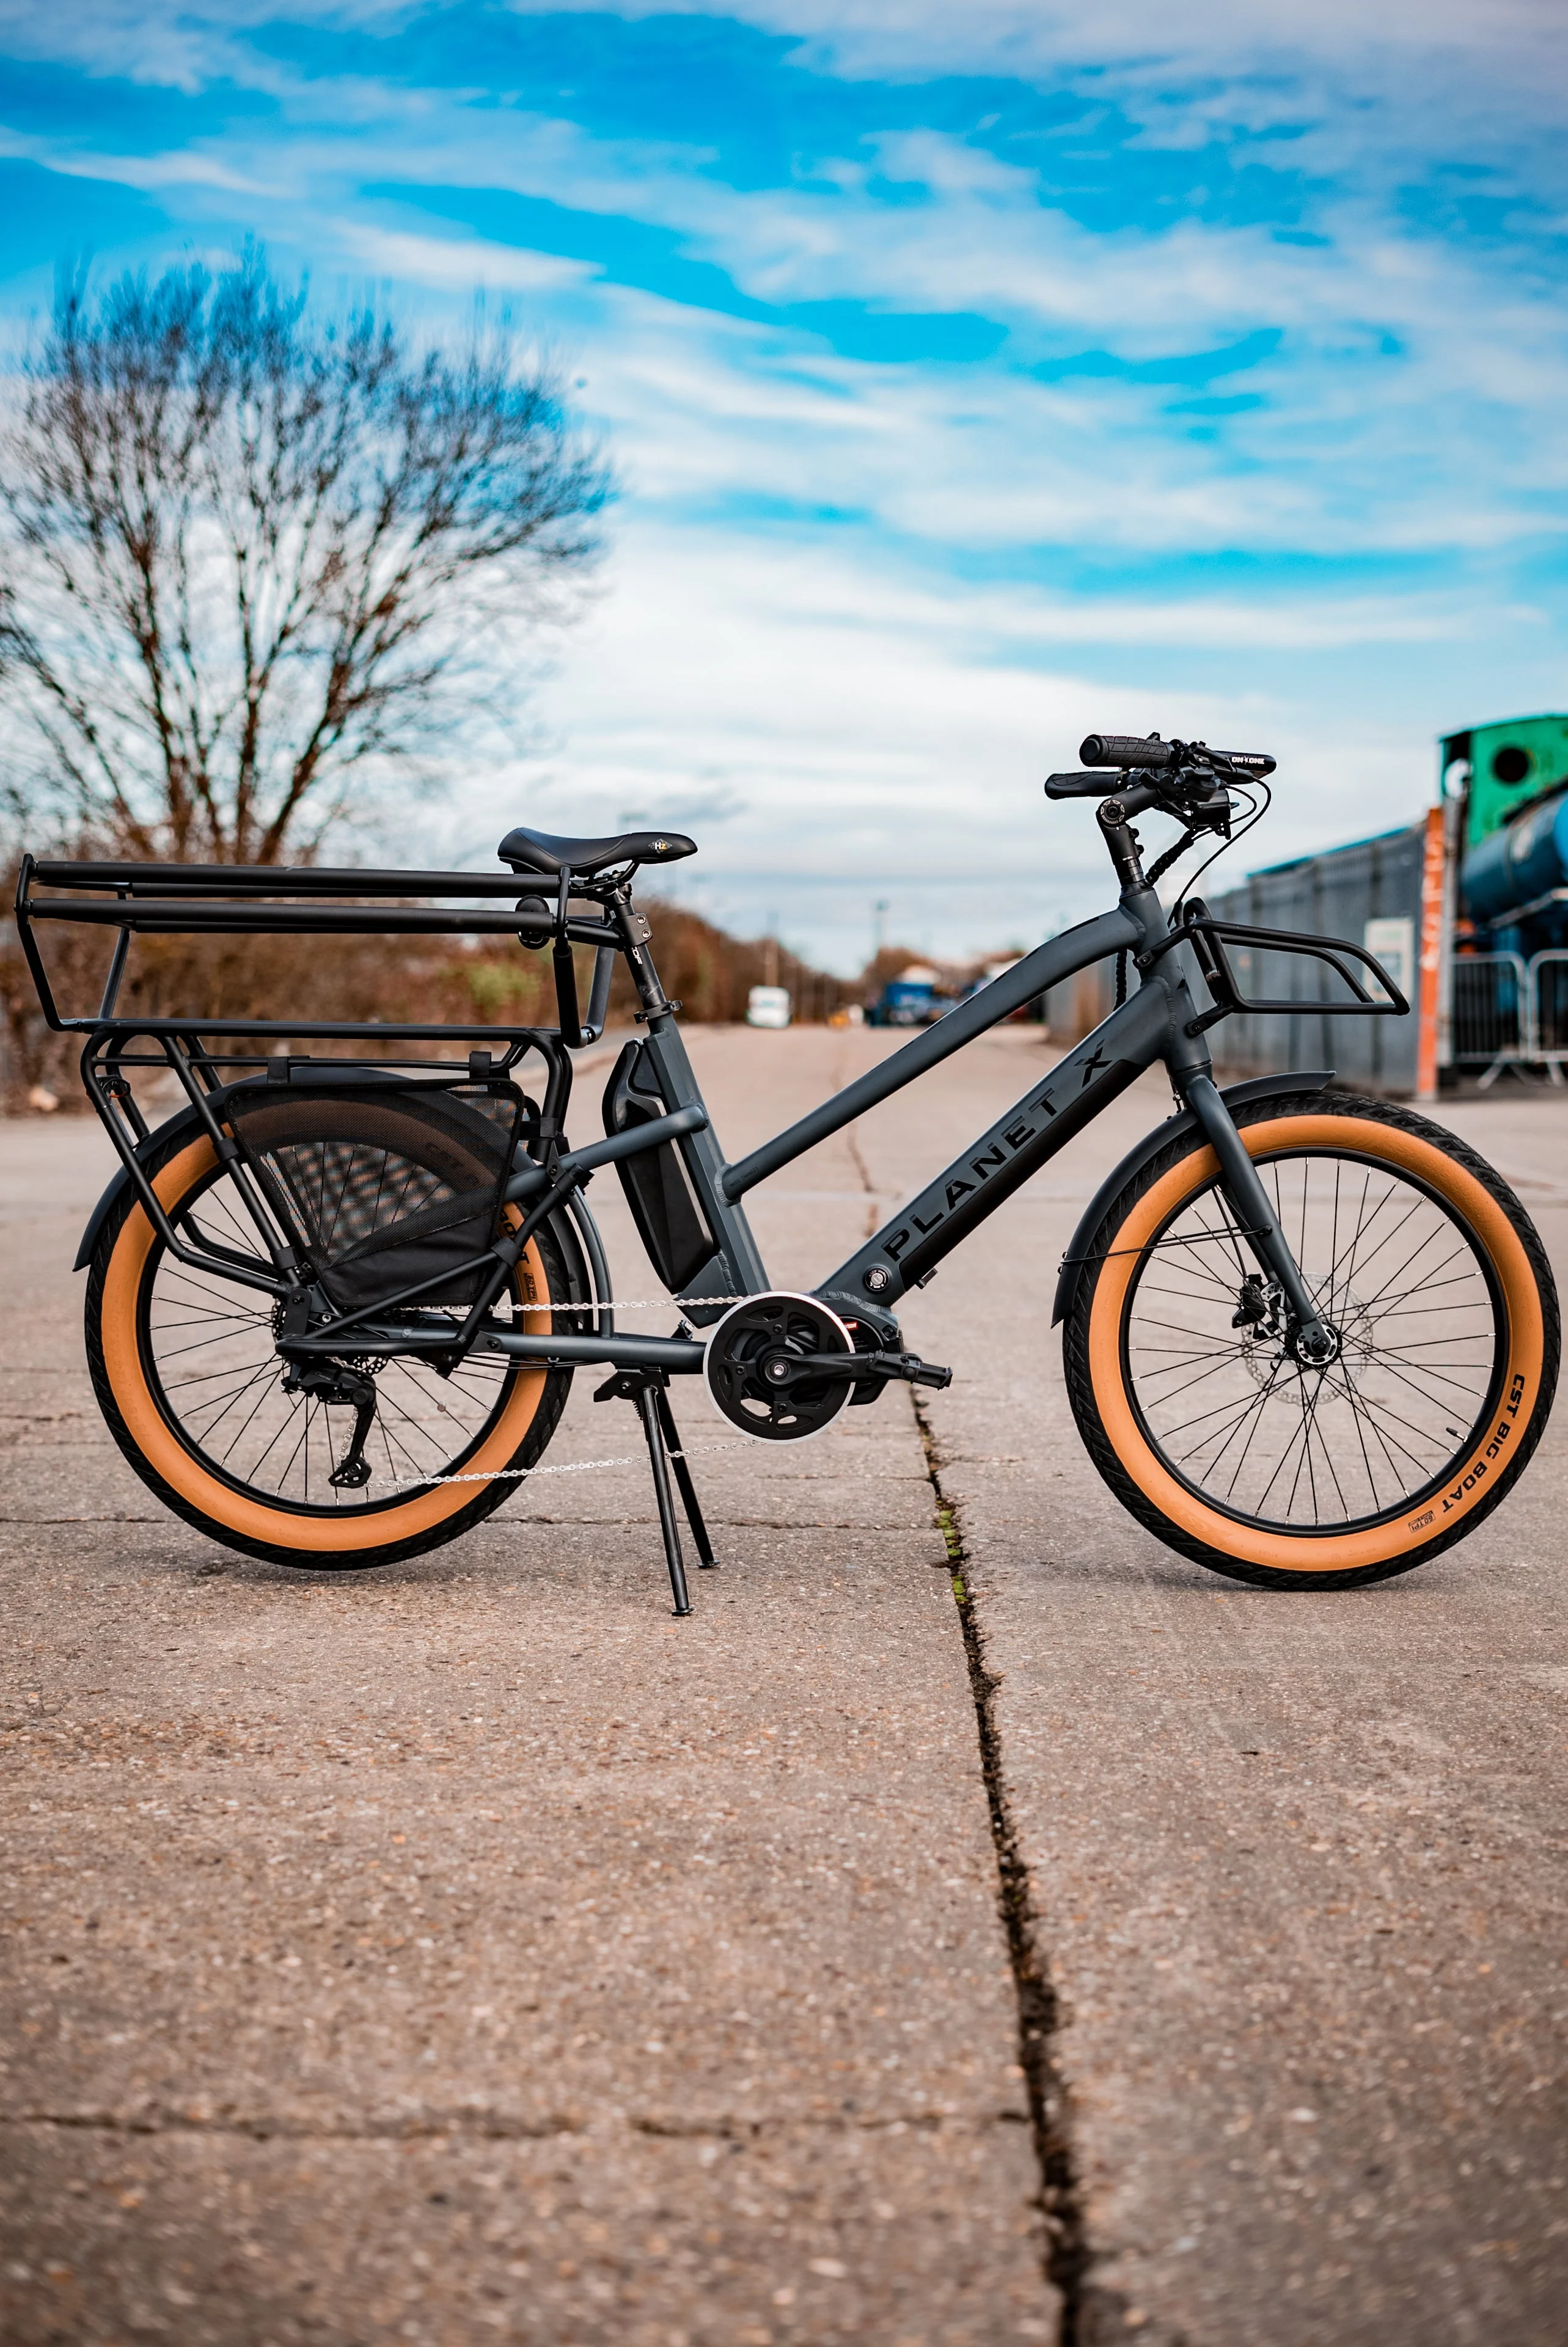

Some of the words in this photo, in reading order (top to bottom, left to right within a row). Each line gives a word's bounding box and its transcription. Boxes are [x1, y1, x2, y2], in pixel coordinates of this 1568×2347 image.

[881, 1087, 1058, 1262] PLANET
[1074, 1039, 1113, 1088] X
[1506, 1374, 1525, 1418] CST
[1486, 1421, 1511, 1459] BIG
[1442, 1461, 1488, 1513] BOAT
[1412, 1521, 1424, 1531] TPI
[1424, 1515, 1434, 1524] 60
